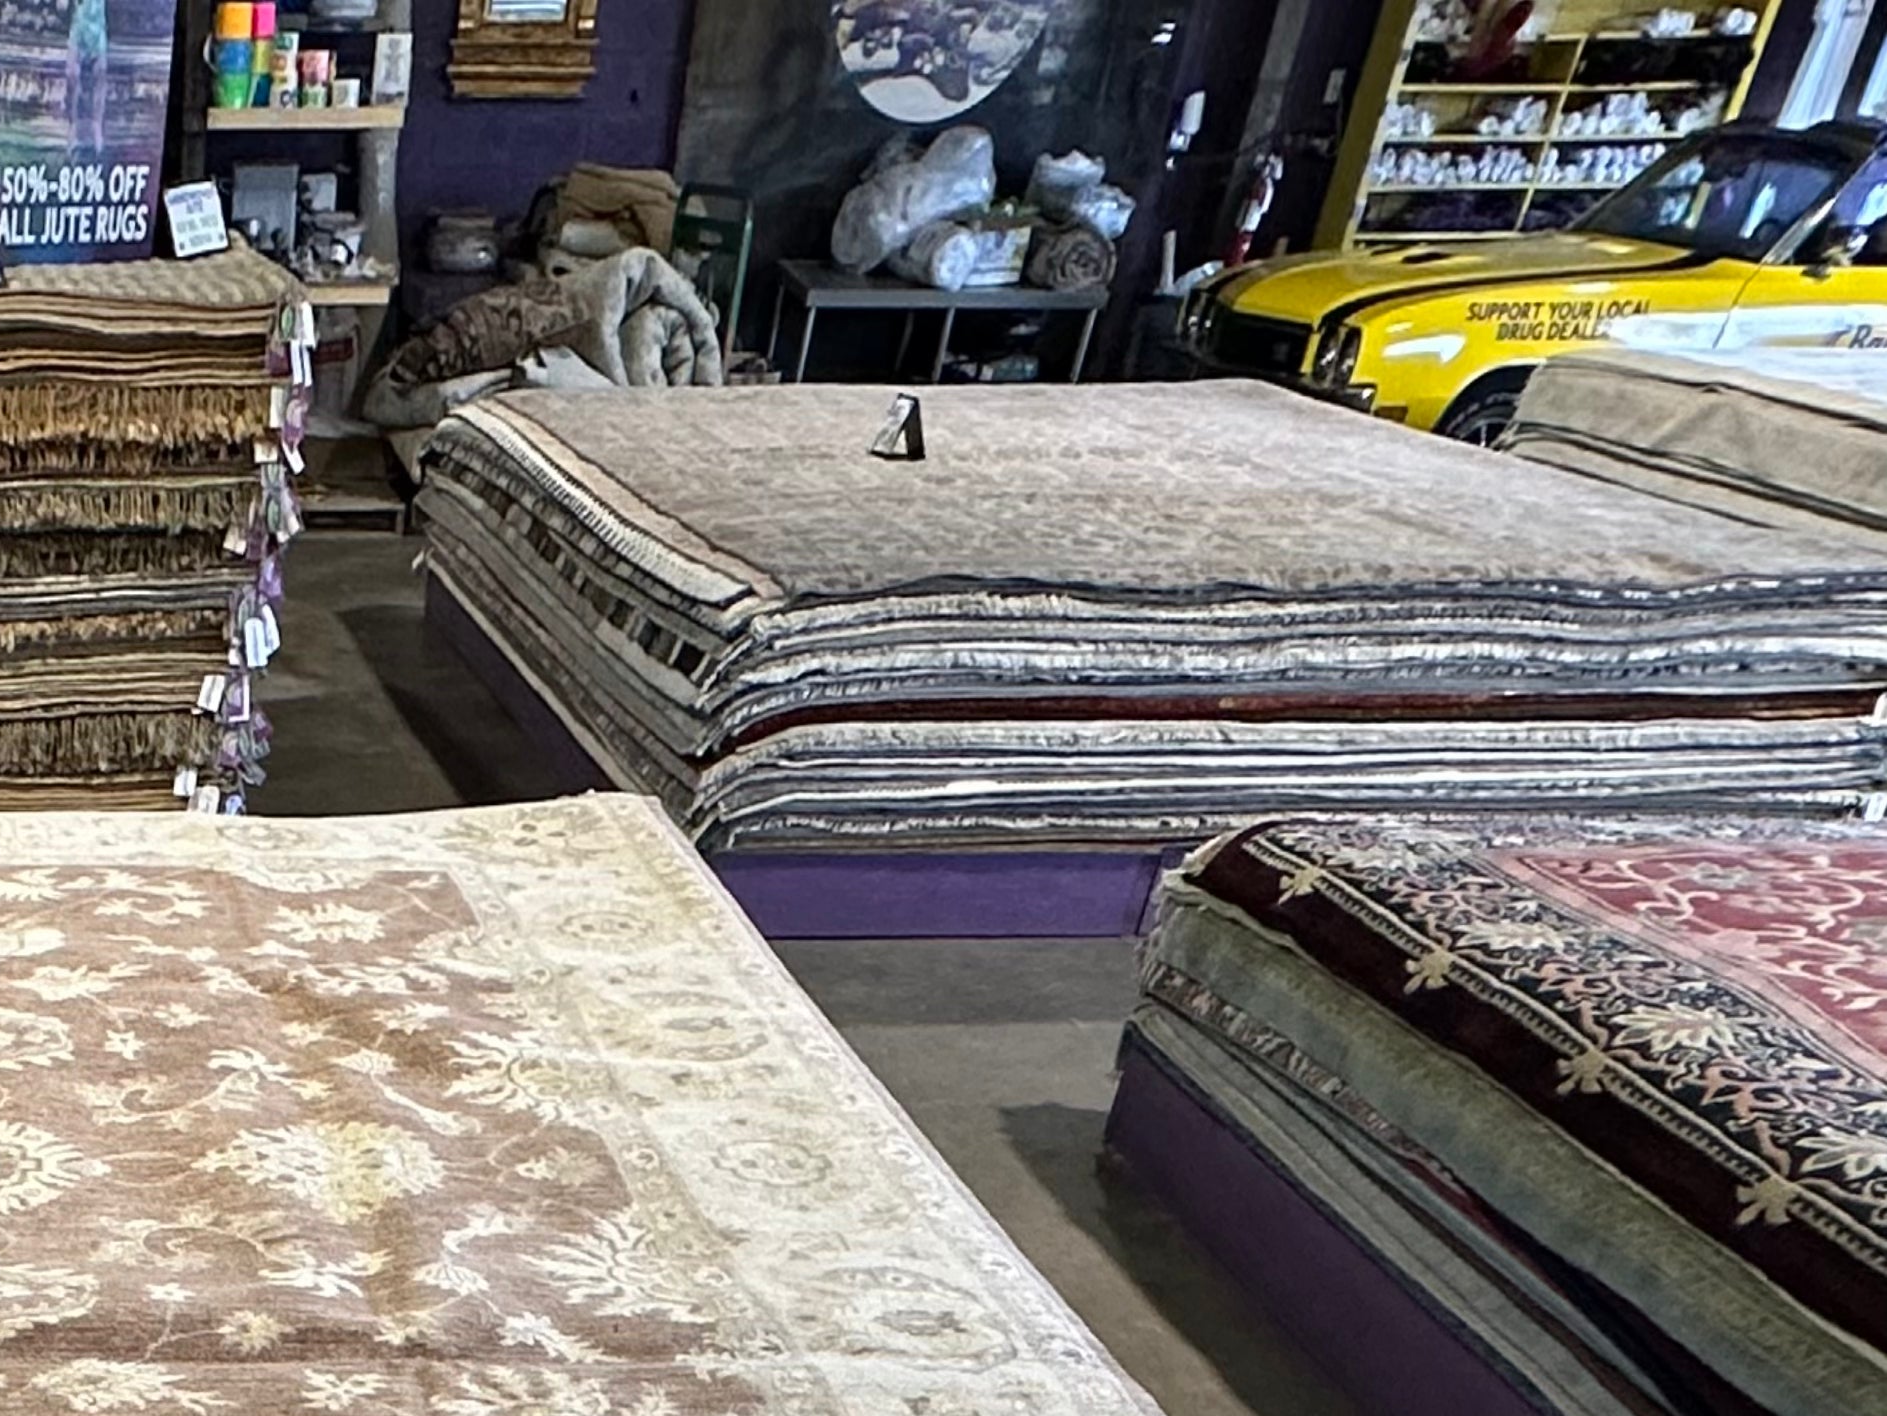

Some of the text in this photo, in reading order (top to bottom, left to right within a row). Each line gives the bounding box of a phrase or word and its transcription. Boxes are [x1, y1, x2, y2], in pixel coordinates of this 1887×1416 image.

[1, 164, 104, 204] 50%-80%
[109, 165, 150, 203] OFF
[40, 206, 93, 244] JUTE
[94, 204, 149, 243] RUGS
[1465, 299, 1651, 321] SUPPORT YOUR LOCAL
[1496, 321, 1545, 341] DRUG
